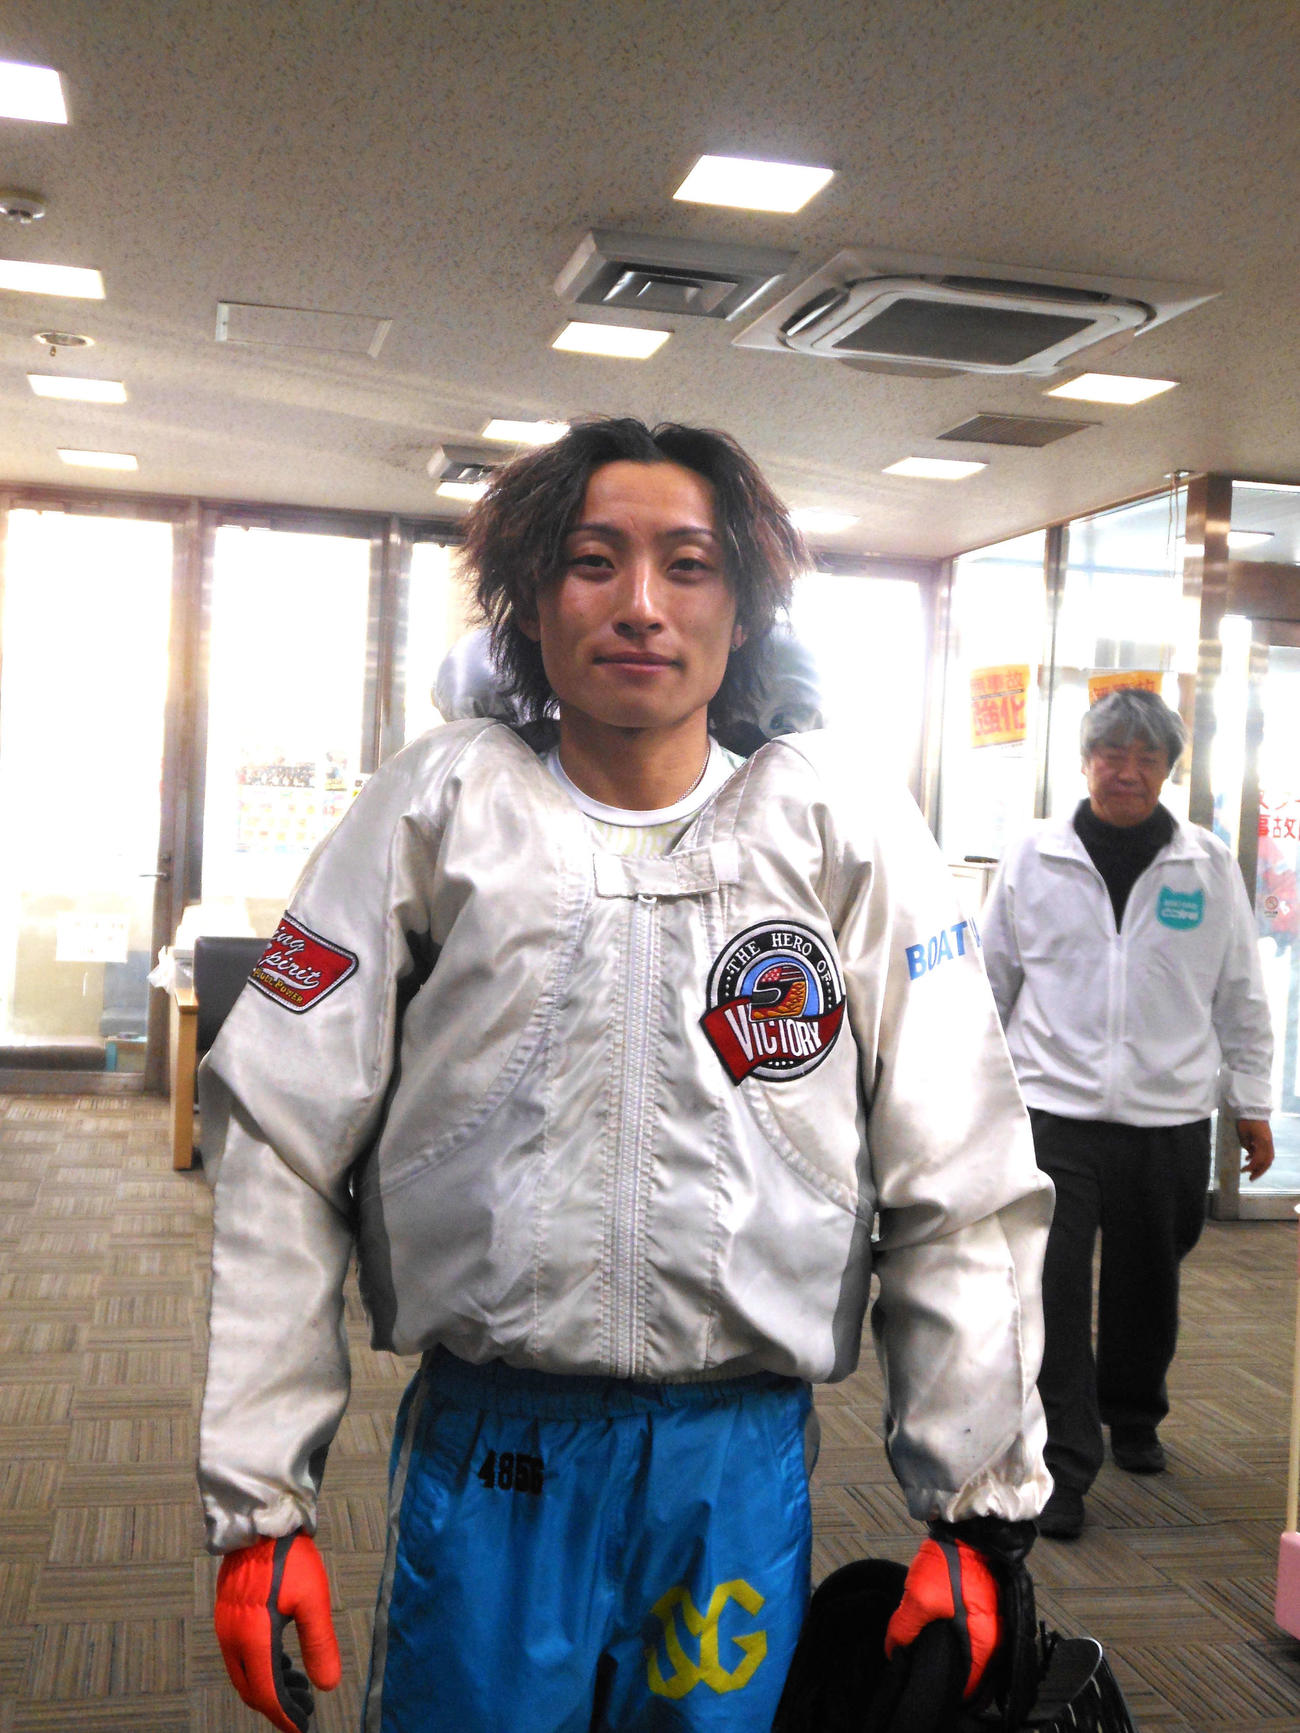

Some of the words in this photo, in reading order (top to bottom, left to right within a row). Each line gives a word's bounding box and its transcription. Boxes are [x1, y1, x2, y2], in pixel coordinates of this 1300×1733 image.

[1258, 814, 1300, 841] 事故
[257, 943, 321, 986] pirit
[727, 940, 760, 973] THE
[771, 933, 812, 956] HERO
[817, 959, 832, 983] OF
[724, 1004, 822, 1062] VICTORY
